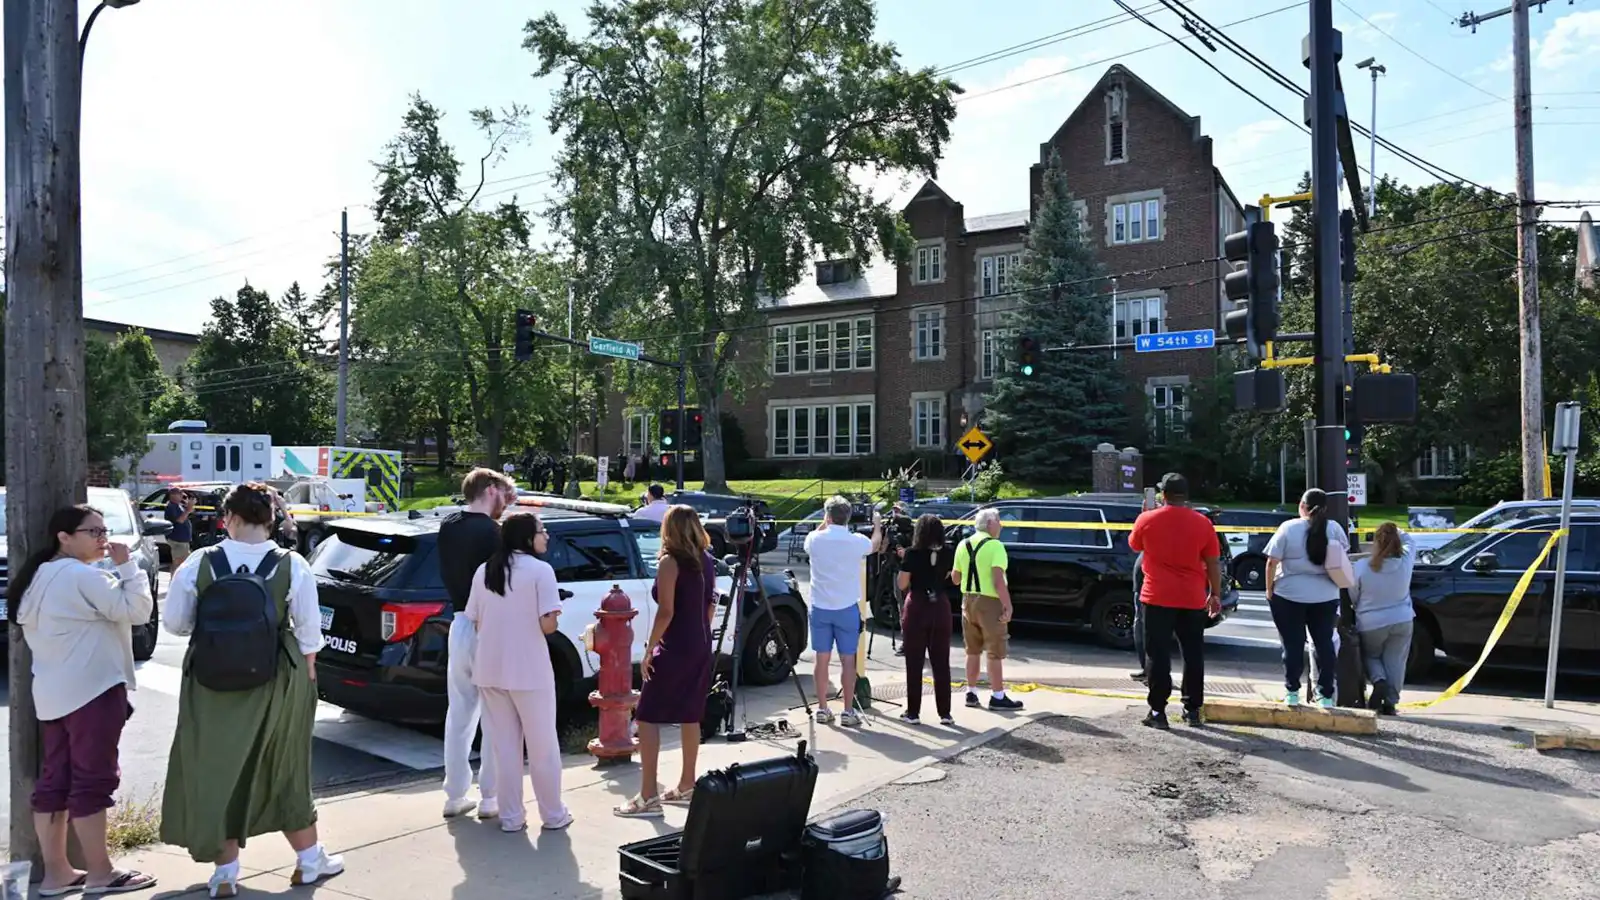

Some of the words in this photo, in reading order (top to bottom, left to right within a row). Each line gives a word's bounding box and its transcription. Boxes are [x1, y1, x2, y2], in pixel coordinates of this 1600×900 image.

[592, 341, 624, 354] Garfield
[1141, 338, 1150, 348] W
[1157, 336, 1188, 347] 54th
[1194, 334, 1208, 344] St
